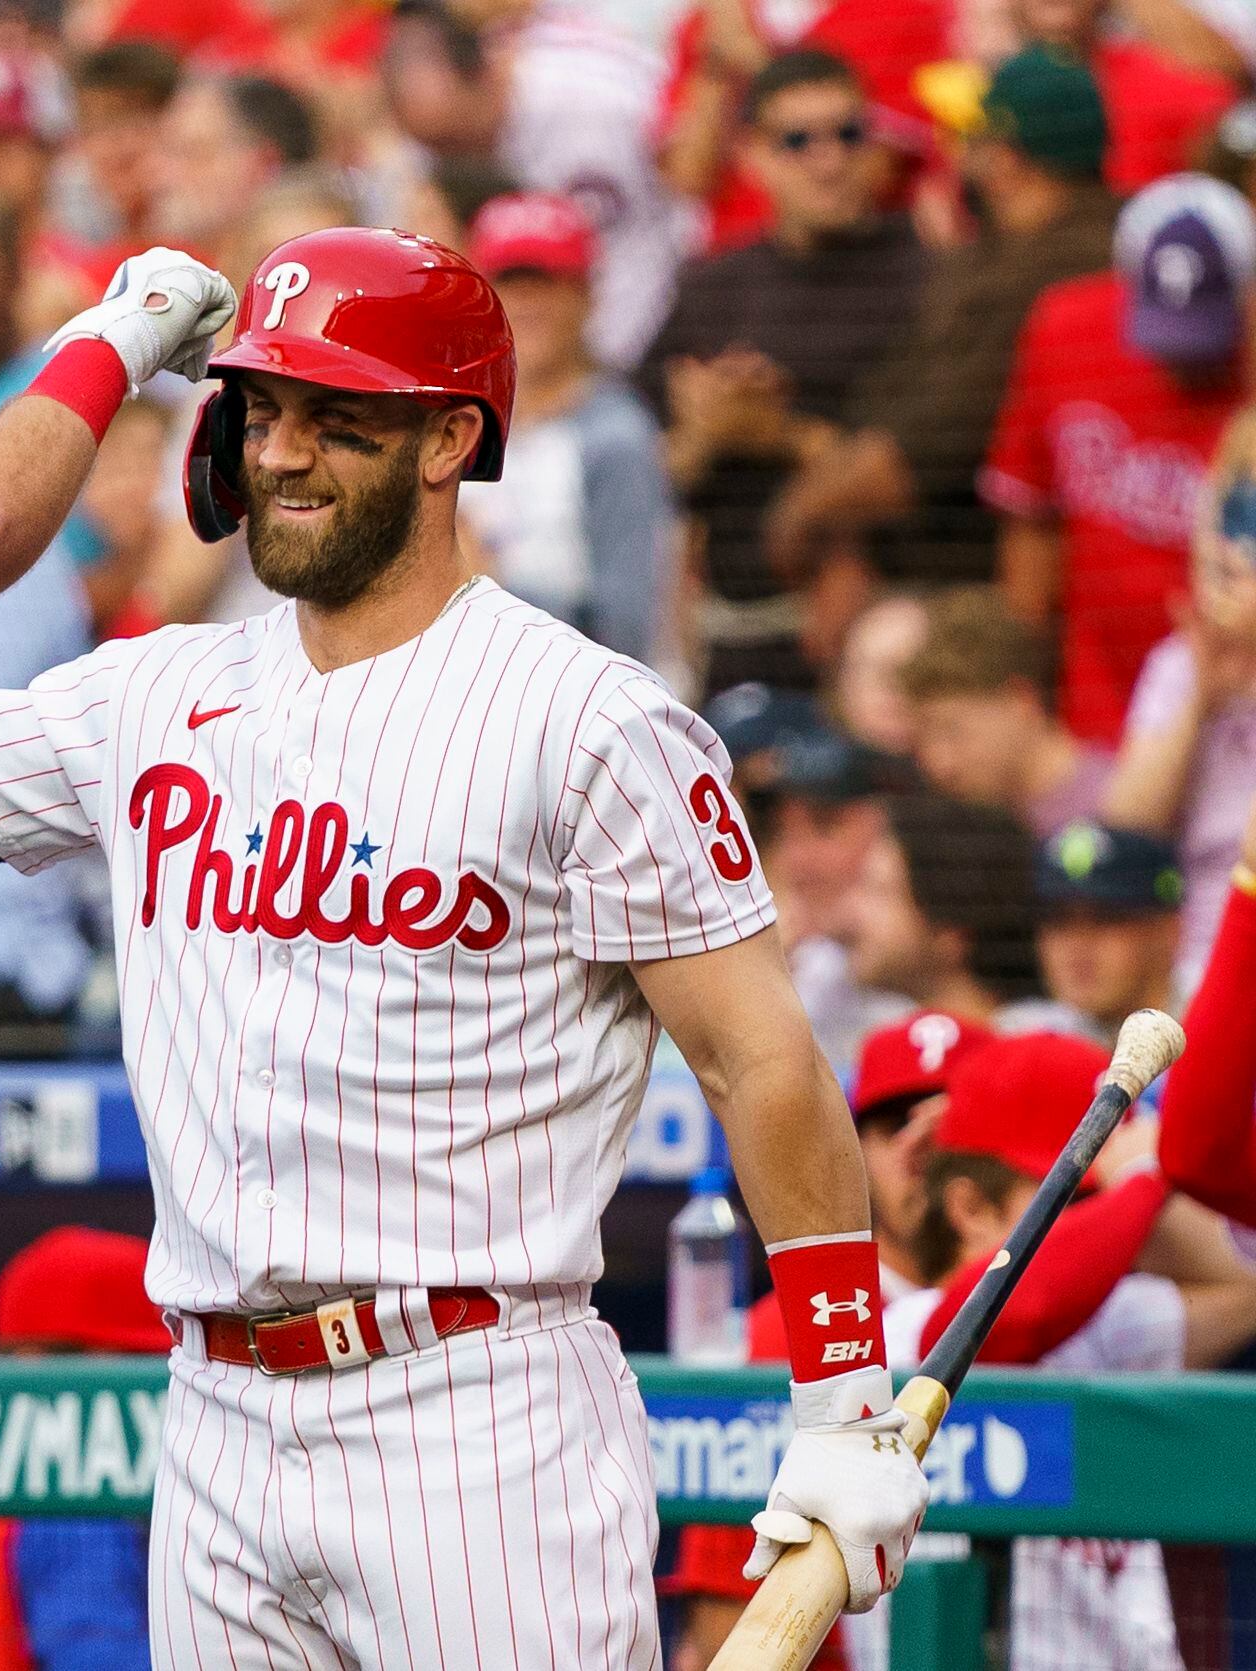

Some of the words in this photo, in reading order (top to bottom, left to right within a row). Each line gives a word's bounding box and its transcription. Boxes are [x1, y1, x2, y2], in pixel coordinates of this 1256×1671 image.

[263, 261, 310, 330] P
[128, 762, 511, 951] Phillies
[689, 772, 753, 882] 3
[331, 1319, 351, 1355] 3
[821, 1339, 874, 1363] BH
